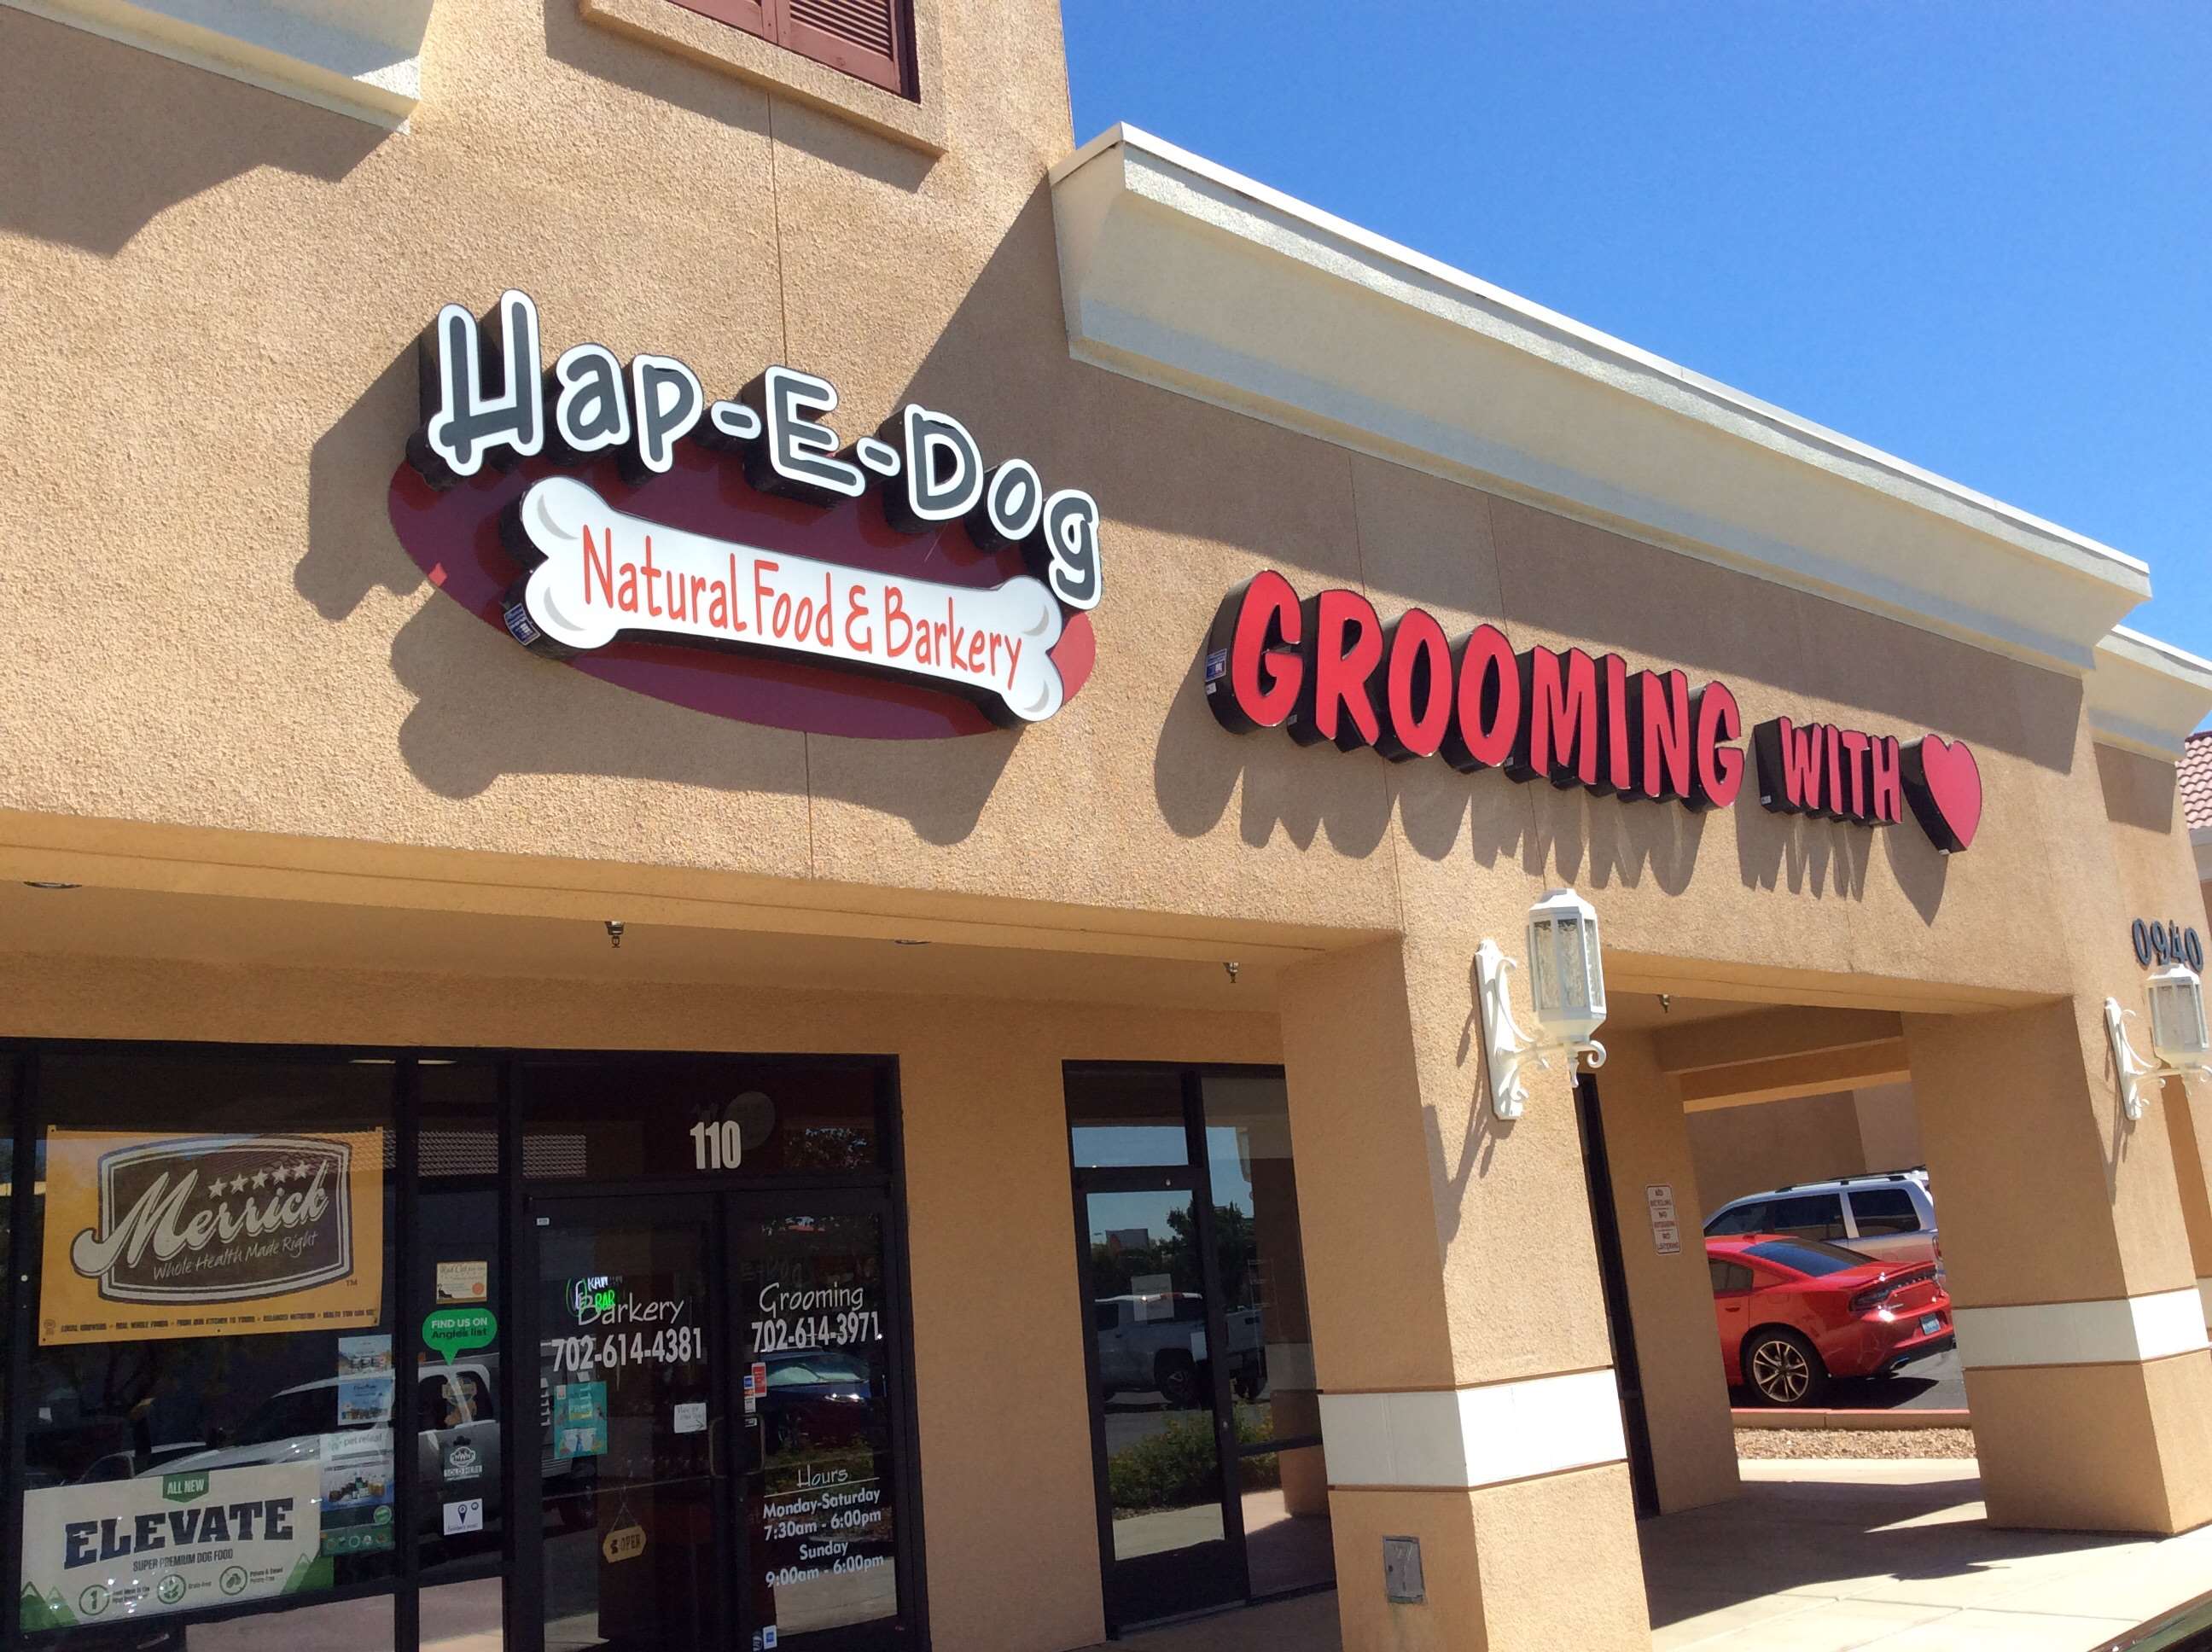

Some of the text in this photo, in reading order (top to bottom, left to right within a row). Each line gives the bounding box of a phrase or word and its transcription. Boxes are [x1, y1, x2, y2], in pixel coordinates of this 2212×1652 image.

[429, 288, 1103, 610] Hap-E-Dog
[582, 524, 1022, 690] Natural Food & Barkery
[1229, 568, 1903, 824] GROOMING WITH
[2131, 917, 2204, 974] 0940
[690, 1120, 742, 1170] 110
[73, 1159, 331, 1276] Merrick
[154, 1230, 319, 1282] Whole Health Made Right
[577, 1292, 685, 1326] Barkery
[759, 1282, 864, 1319] Grooming
[431, 1317, 488, 1329] FIND US ON
[470, 1327, 487, 1336] list
[751, 1312, 881, 1353] 702-614-3971
[550, 1326, 702, 1372] 702-614-4381
[167, 1478, 205, 1495] ALL NEW
[796, 1464, 849, 1488] Hours
[763, 1487, 882, 1520] Monday-Saturday
[64, 1498, 293, 1569] ELEVATE
[620, 1534, 641, 1551] OPEN
[764, 1521, 818, 1542] 7:30am
[830, 1509, 882, 1532] 6:00pm
[133, 1548, 234, 1572] SUPER PREMIUM DOG FOOD
[799, 1540, 849, 1562] Sunday
[765, 1567, 820, 1588] 9:00am
[833, 1554, 885, 1579] 6:00pm
